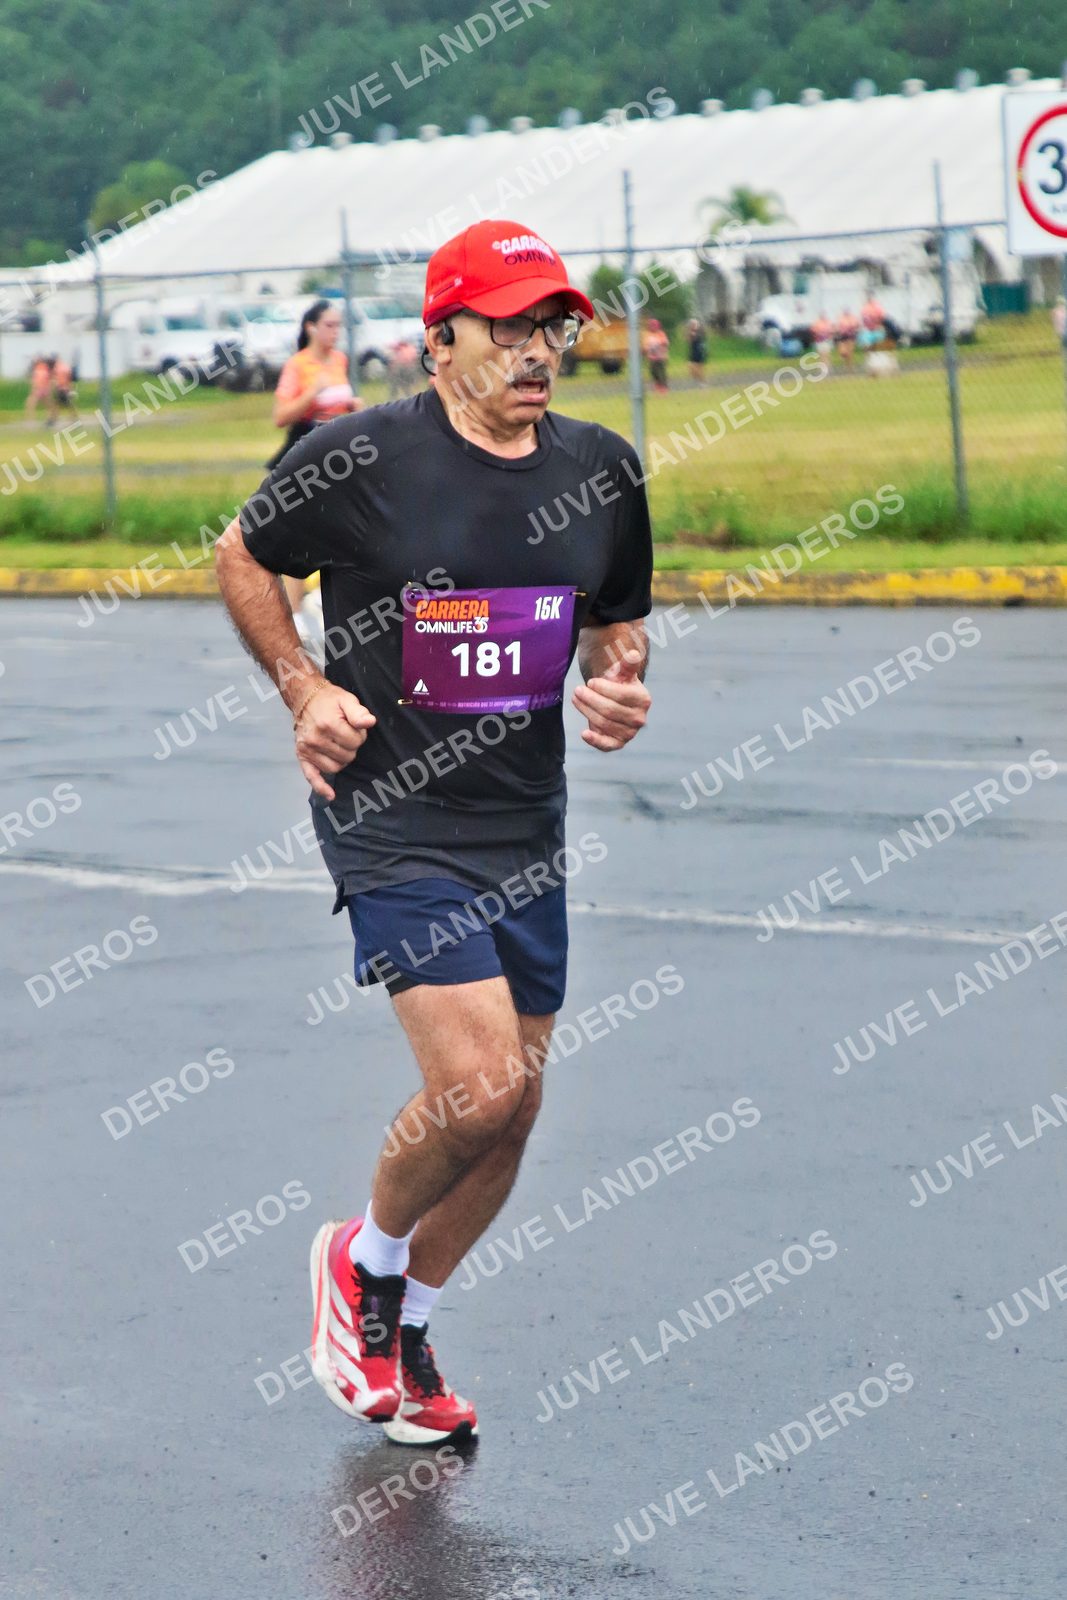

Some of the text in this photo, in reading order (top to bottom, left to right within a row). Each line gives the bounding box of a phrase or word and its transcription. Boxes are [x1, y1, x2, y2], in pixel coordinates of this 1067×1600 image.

[415, 600, 489, 620] CARRERA
[534, 595, 564, 621] 15K
[451, 641, 521, 678] 181
